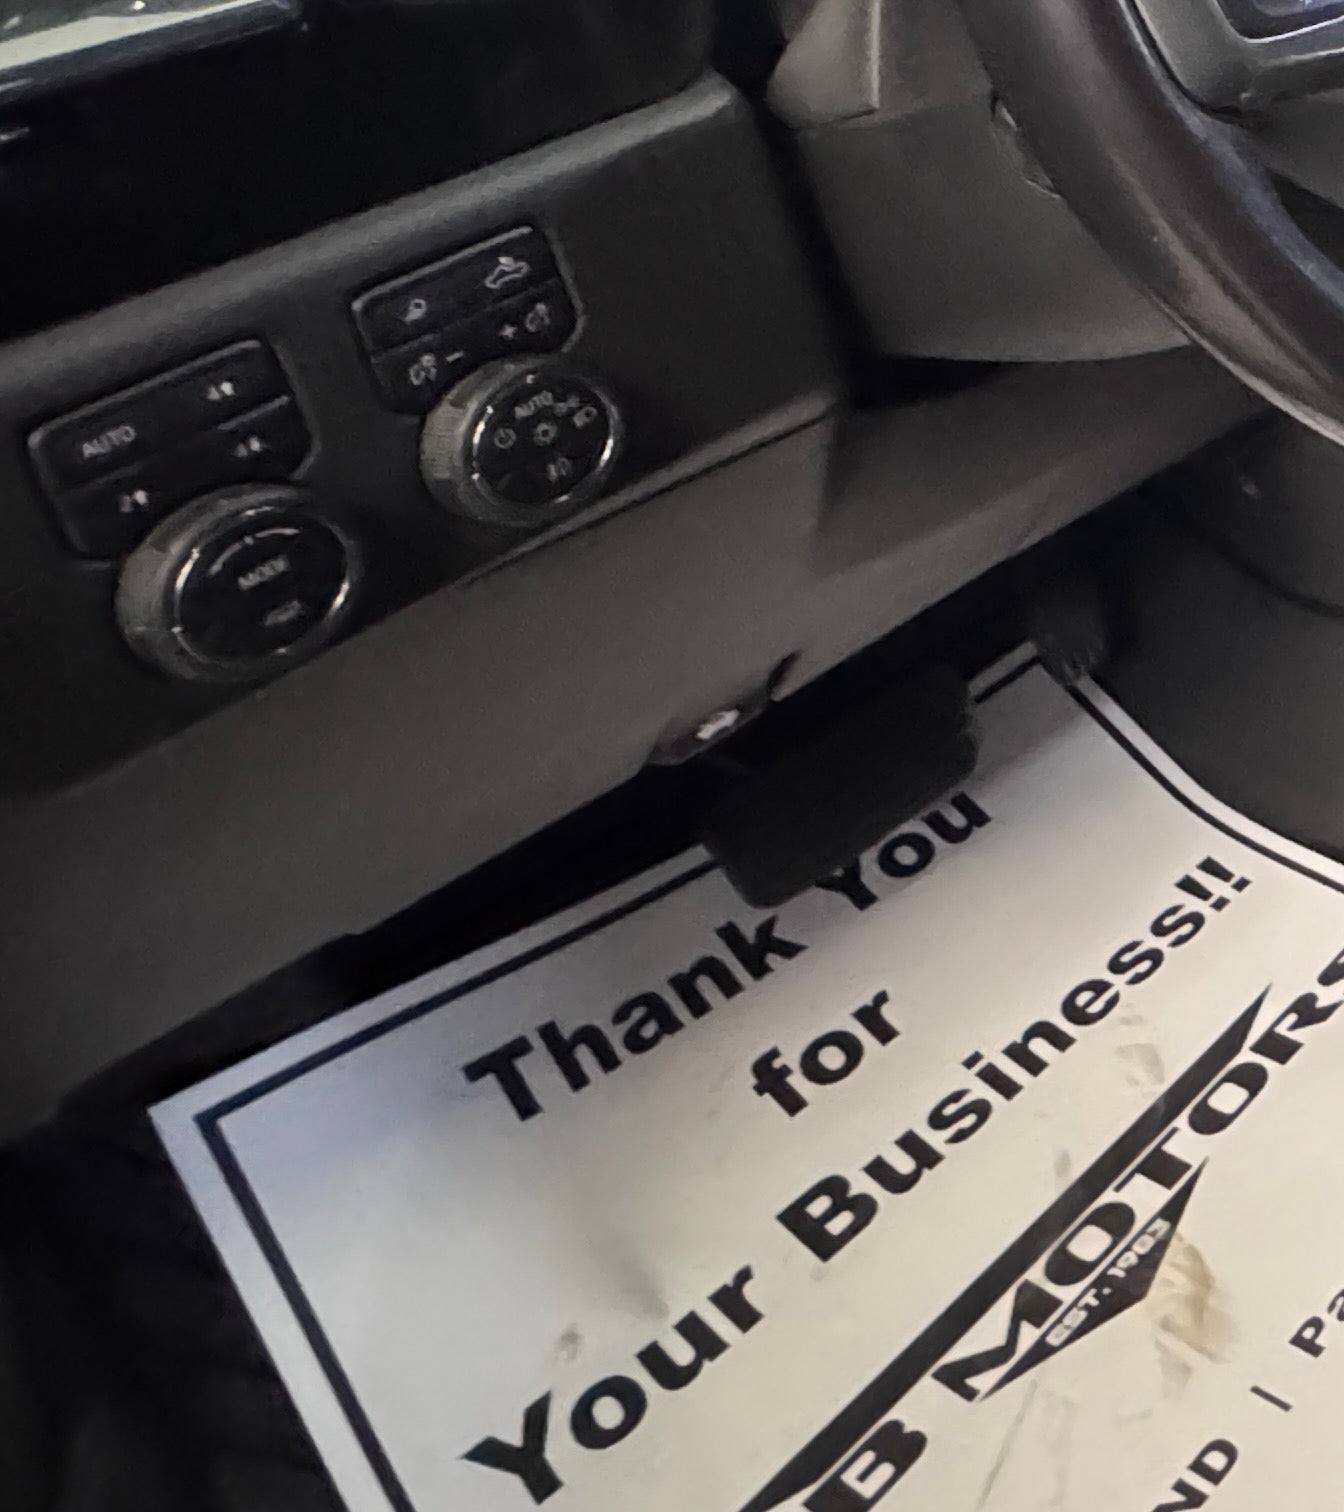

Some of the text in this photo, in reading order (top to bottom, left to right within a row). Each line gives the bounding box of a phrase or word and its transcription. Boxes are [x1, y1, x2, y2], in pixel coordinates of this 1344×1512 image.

[82, 424, 138, 460] AUTO
[512, 390, 555, 420] AUTO
[461, 792, 992, 1122] Thank You
[747, 989, 901, 1118] for
[460, 855, 1253, 1505] Your Business!!
[1044, 1287, 1113, 1347] EST.
[1150, 1438, 1240, 1512] ND
